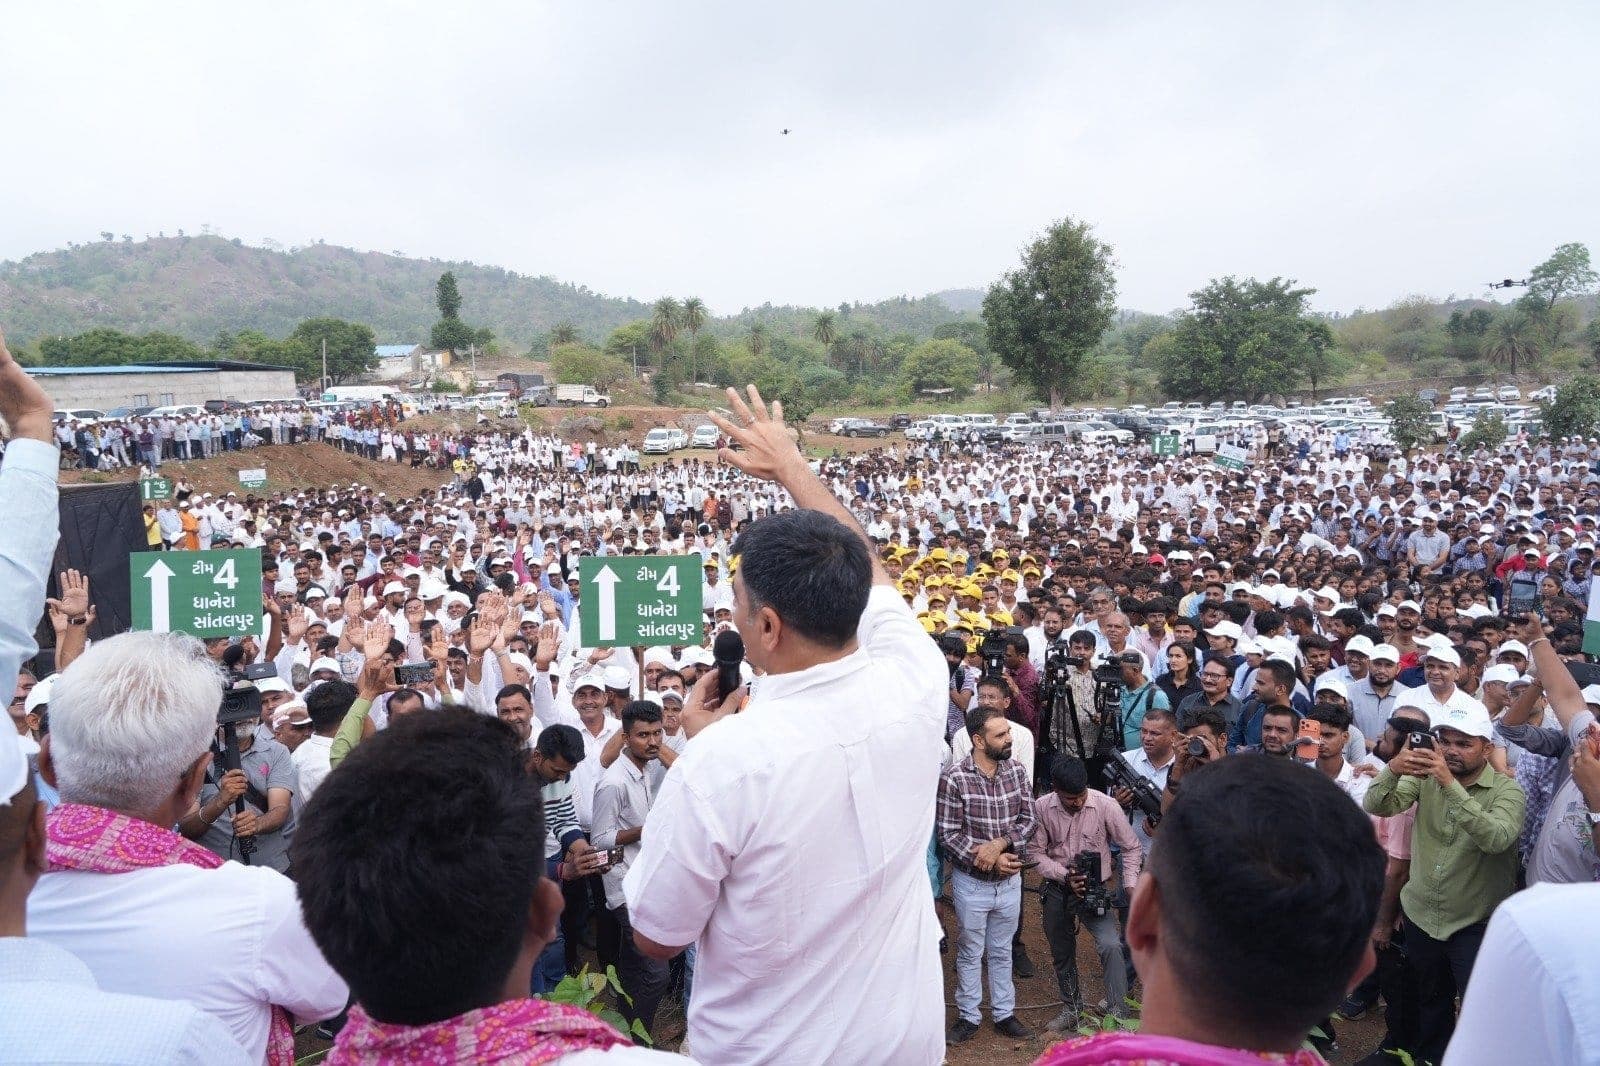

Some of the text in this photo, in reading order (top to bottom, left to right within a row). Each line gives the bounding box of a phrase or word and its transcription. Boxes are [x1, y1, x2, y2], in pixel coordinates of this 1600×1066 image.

[192, 559, 239, 589] ટીમ 4
[637, 566, 681, 596] ટીમ 4
[193, 592, 235, 609] ધાનેરા
[637, 600, 677, 617] ધાનેરા
[193, 613, 254, 631] સાંતલપુર
[638, 621, 695, 640] સાંતલપુર
